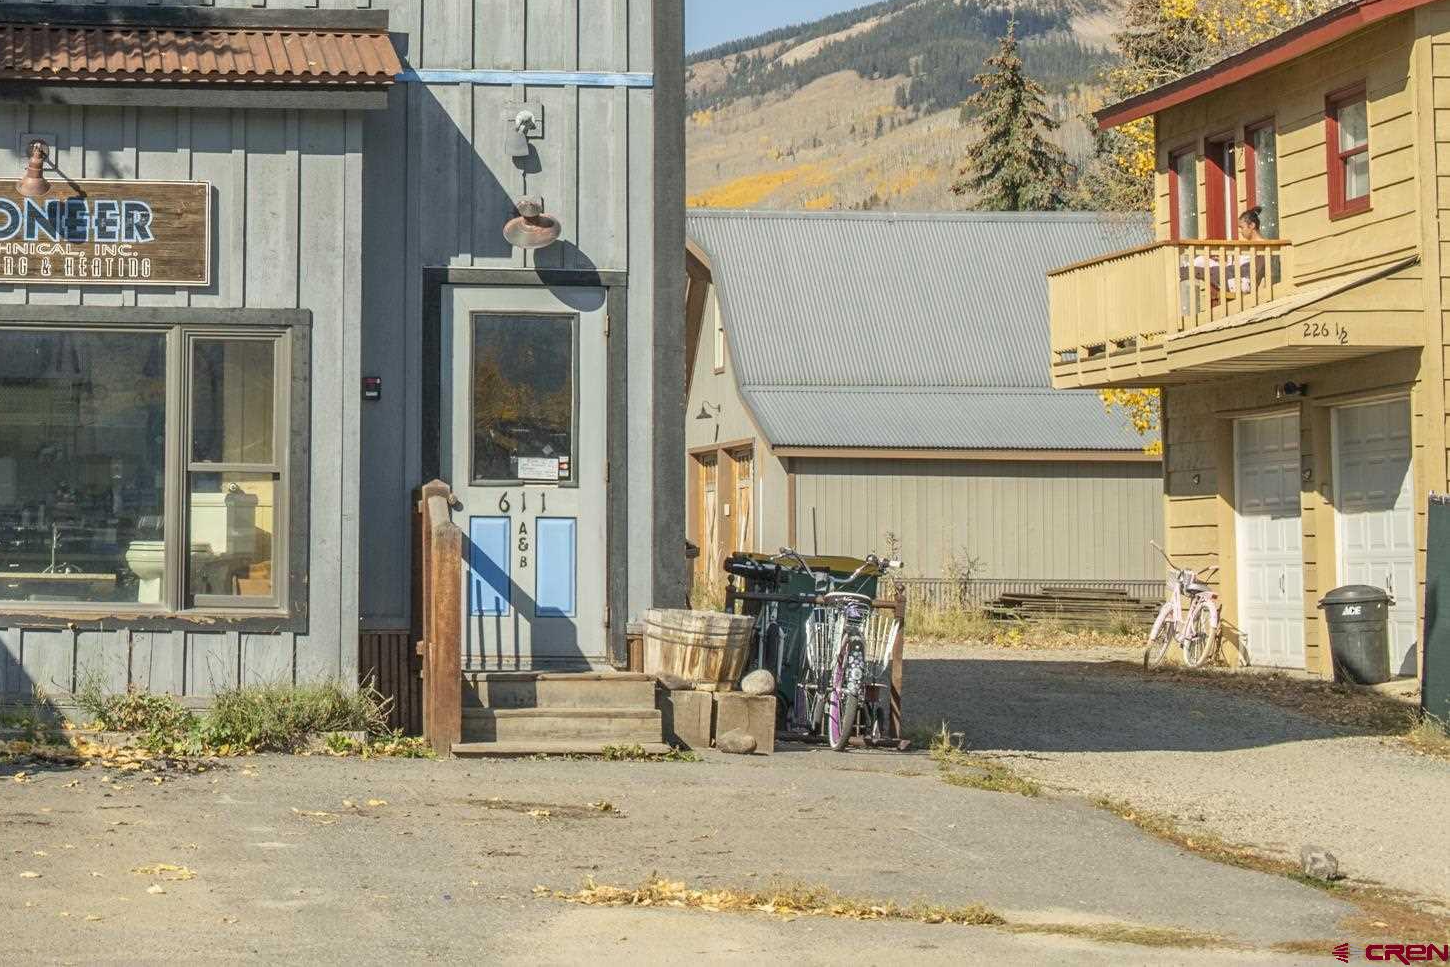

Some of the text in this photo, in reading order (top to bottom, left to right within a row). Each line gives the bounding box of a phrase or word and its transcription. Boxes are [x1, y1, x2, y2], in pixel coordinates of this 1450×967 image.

[94, 243, 139, 257] INC.
[41, 257, 52, 276] &
[64, 257, 152, 278] HEATING
[1303, 323, 1329, 337] 226
[499, 491, 548, 514] 611
[1341, 605, 1362, 616] ACE
